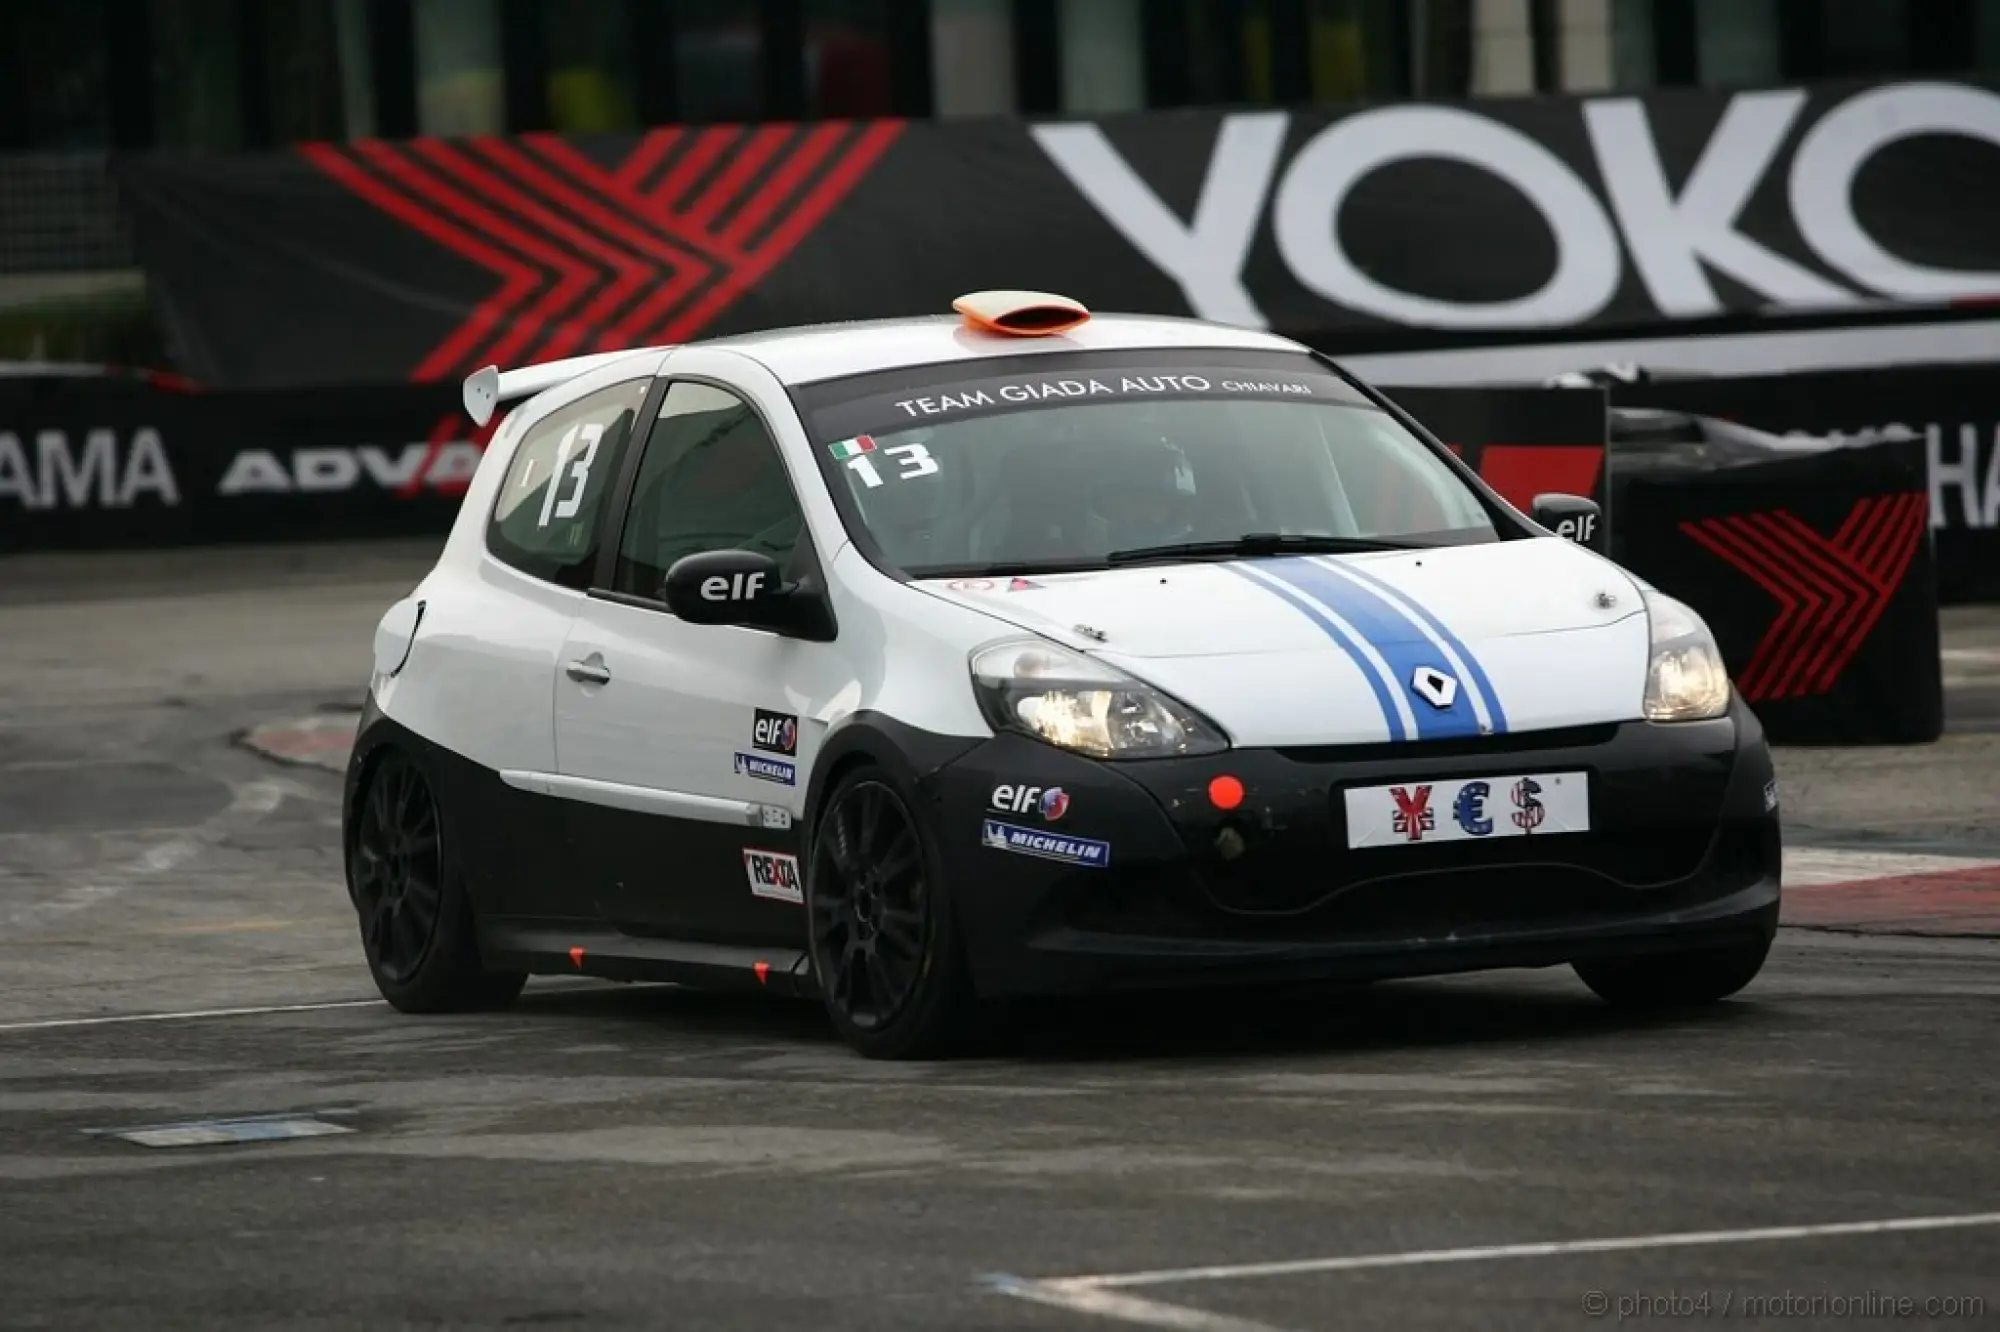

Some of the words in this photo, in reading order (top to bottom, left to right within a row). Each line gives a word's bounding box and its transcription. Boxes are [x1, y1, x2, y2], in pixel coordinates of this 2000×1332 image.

[895, 389, 995, 417] TEAM
[999, 379, 1114, 401] GIADA
[1122, 375, 1210, 392] AUTO
[537, 423, 604, 528] 13
[846, 443, 939, 488] 13
[1557, 513, 1595, 542] elf
[700, 571, 766, 601] elf
[755, 718, 782, 745] elf
[750, 756, 793, 780] MICHELIN
[991, 784, 1041, 813] elf
[1011, 831, 1101, 858] MICHELIN
